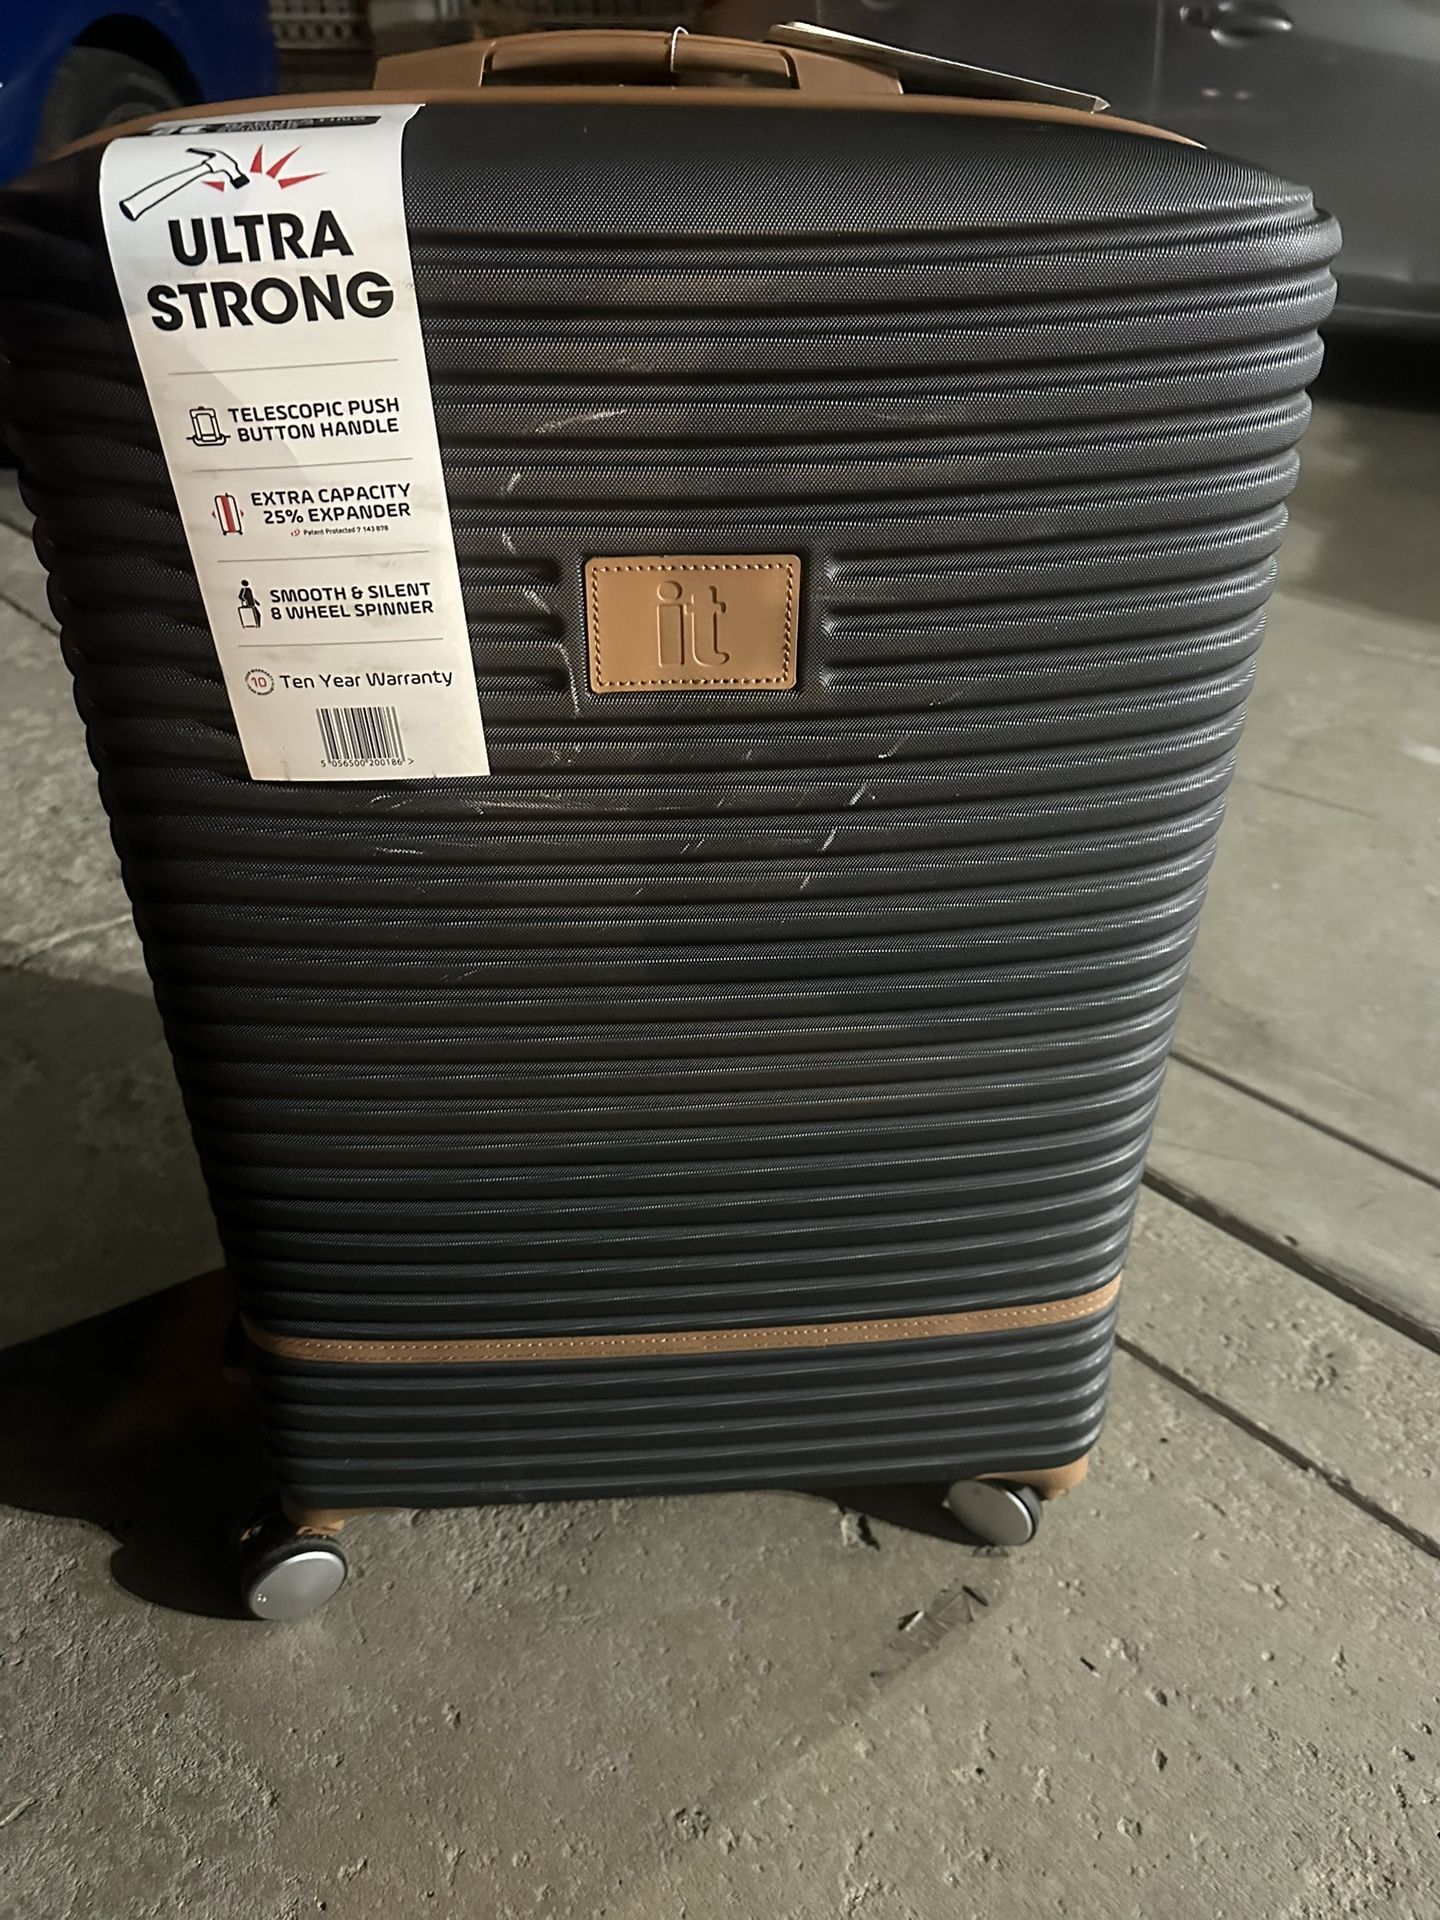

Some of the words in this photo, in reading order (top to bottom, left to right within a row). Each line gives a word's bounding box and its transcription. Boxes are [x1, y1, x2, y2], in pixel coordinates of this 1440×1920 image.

[169, 211, 353, 266] ULTRA
[147, 272, 394, 331] STRONG
[228, 402, 343, 422] TELESCOPIC
[349, 398, 399, 414] PUSH
[238, 422, 315, 442] BUTTON
[321, 418, 399, 437] HANDLE
[251, 491, 314, 506] EXTRA
[319, 483, 410, 502] CAPACITY
[264, 508, 304, 524] 25%
[309, 502, 410, 521] EXPANDER
[303, 528, 324, 536] Patent
[325, 526, 355, 535] Protected
[270, 587, 346, 603] SMOOTH
[351, 586, 363, 599] &
[369, 582, 430, 597] SILENT
[271, 607, 282, 620] 8
[288, 604, 350, 619] WHEEL
[356, 600, 434, 616] SPINNER
[657, 580, 729, 667] it
[251, 677, 267, 688] 10
[280, 674, 315, 688] Ten
[319, 674, 361, 688] Year
[366, 670, 452, 687] Warranty
[331, 759, 366, 767] 056500
[369, 758, 403, 766] 200186
